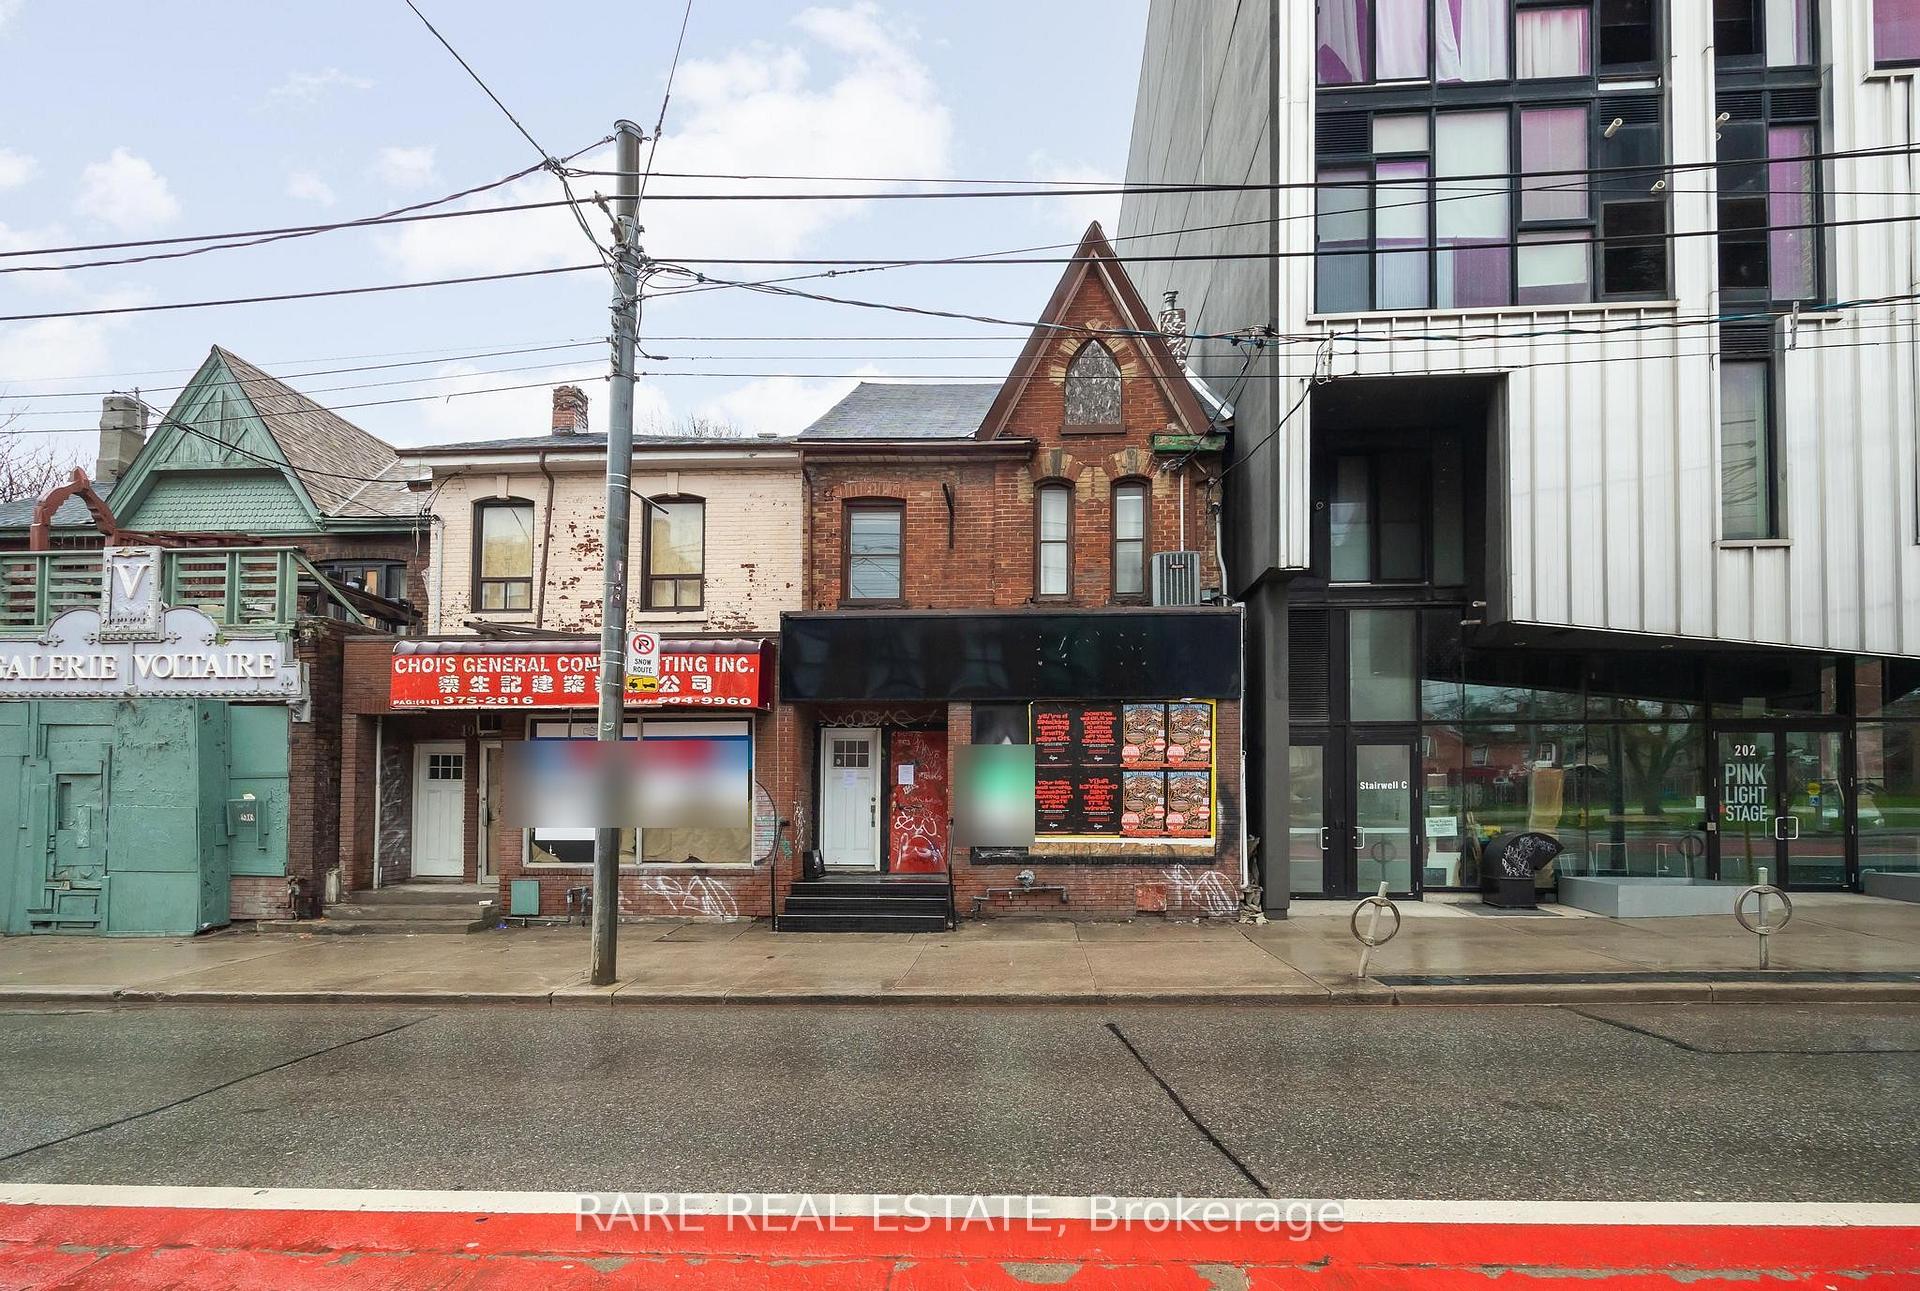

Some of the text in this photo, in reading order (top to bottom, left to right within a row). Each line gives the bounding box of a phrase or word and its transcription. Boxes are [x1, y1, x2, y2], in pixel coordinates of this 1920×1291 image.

[113, 564, 148, 599] V
[133, 653, 277, 680] VOLTAIRE
[394, 656, 457, 674] CHOI'S
[463, 656, 550, 673] GENERAL
[715, 656, 755, 673] INC.
[633, 666, 653, 674] ROUTE
[634, 658, 652, 666] SNOW
[443, 696, 534, 705] 375-2816
[1734, 744, 1756, 757] 202
[1725, 763, 1767, 785] PINK
[1360, 780, 1408, 790] Stairwell C
[1725, 786, 1768, 804] LIGHT
[1725, 805, 1768, 822] STAGE
